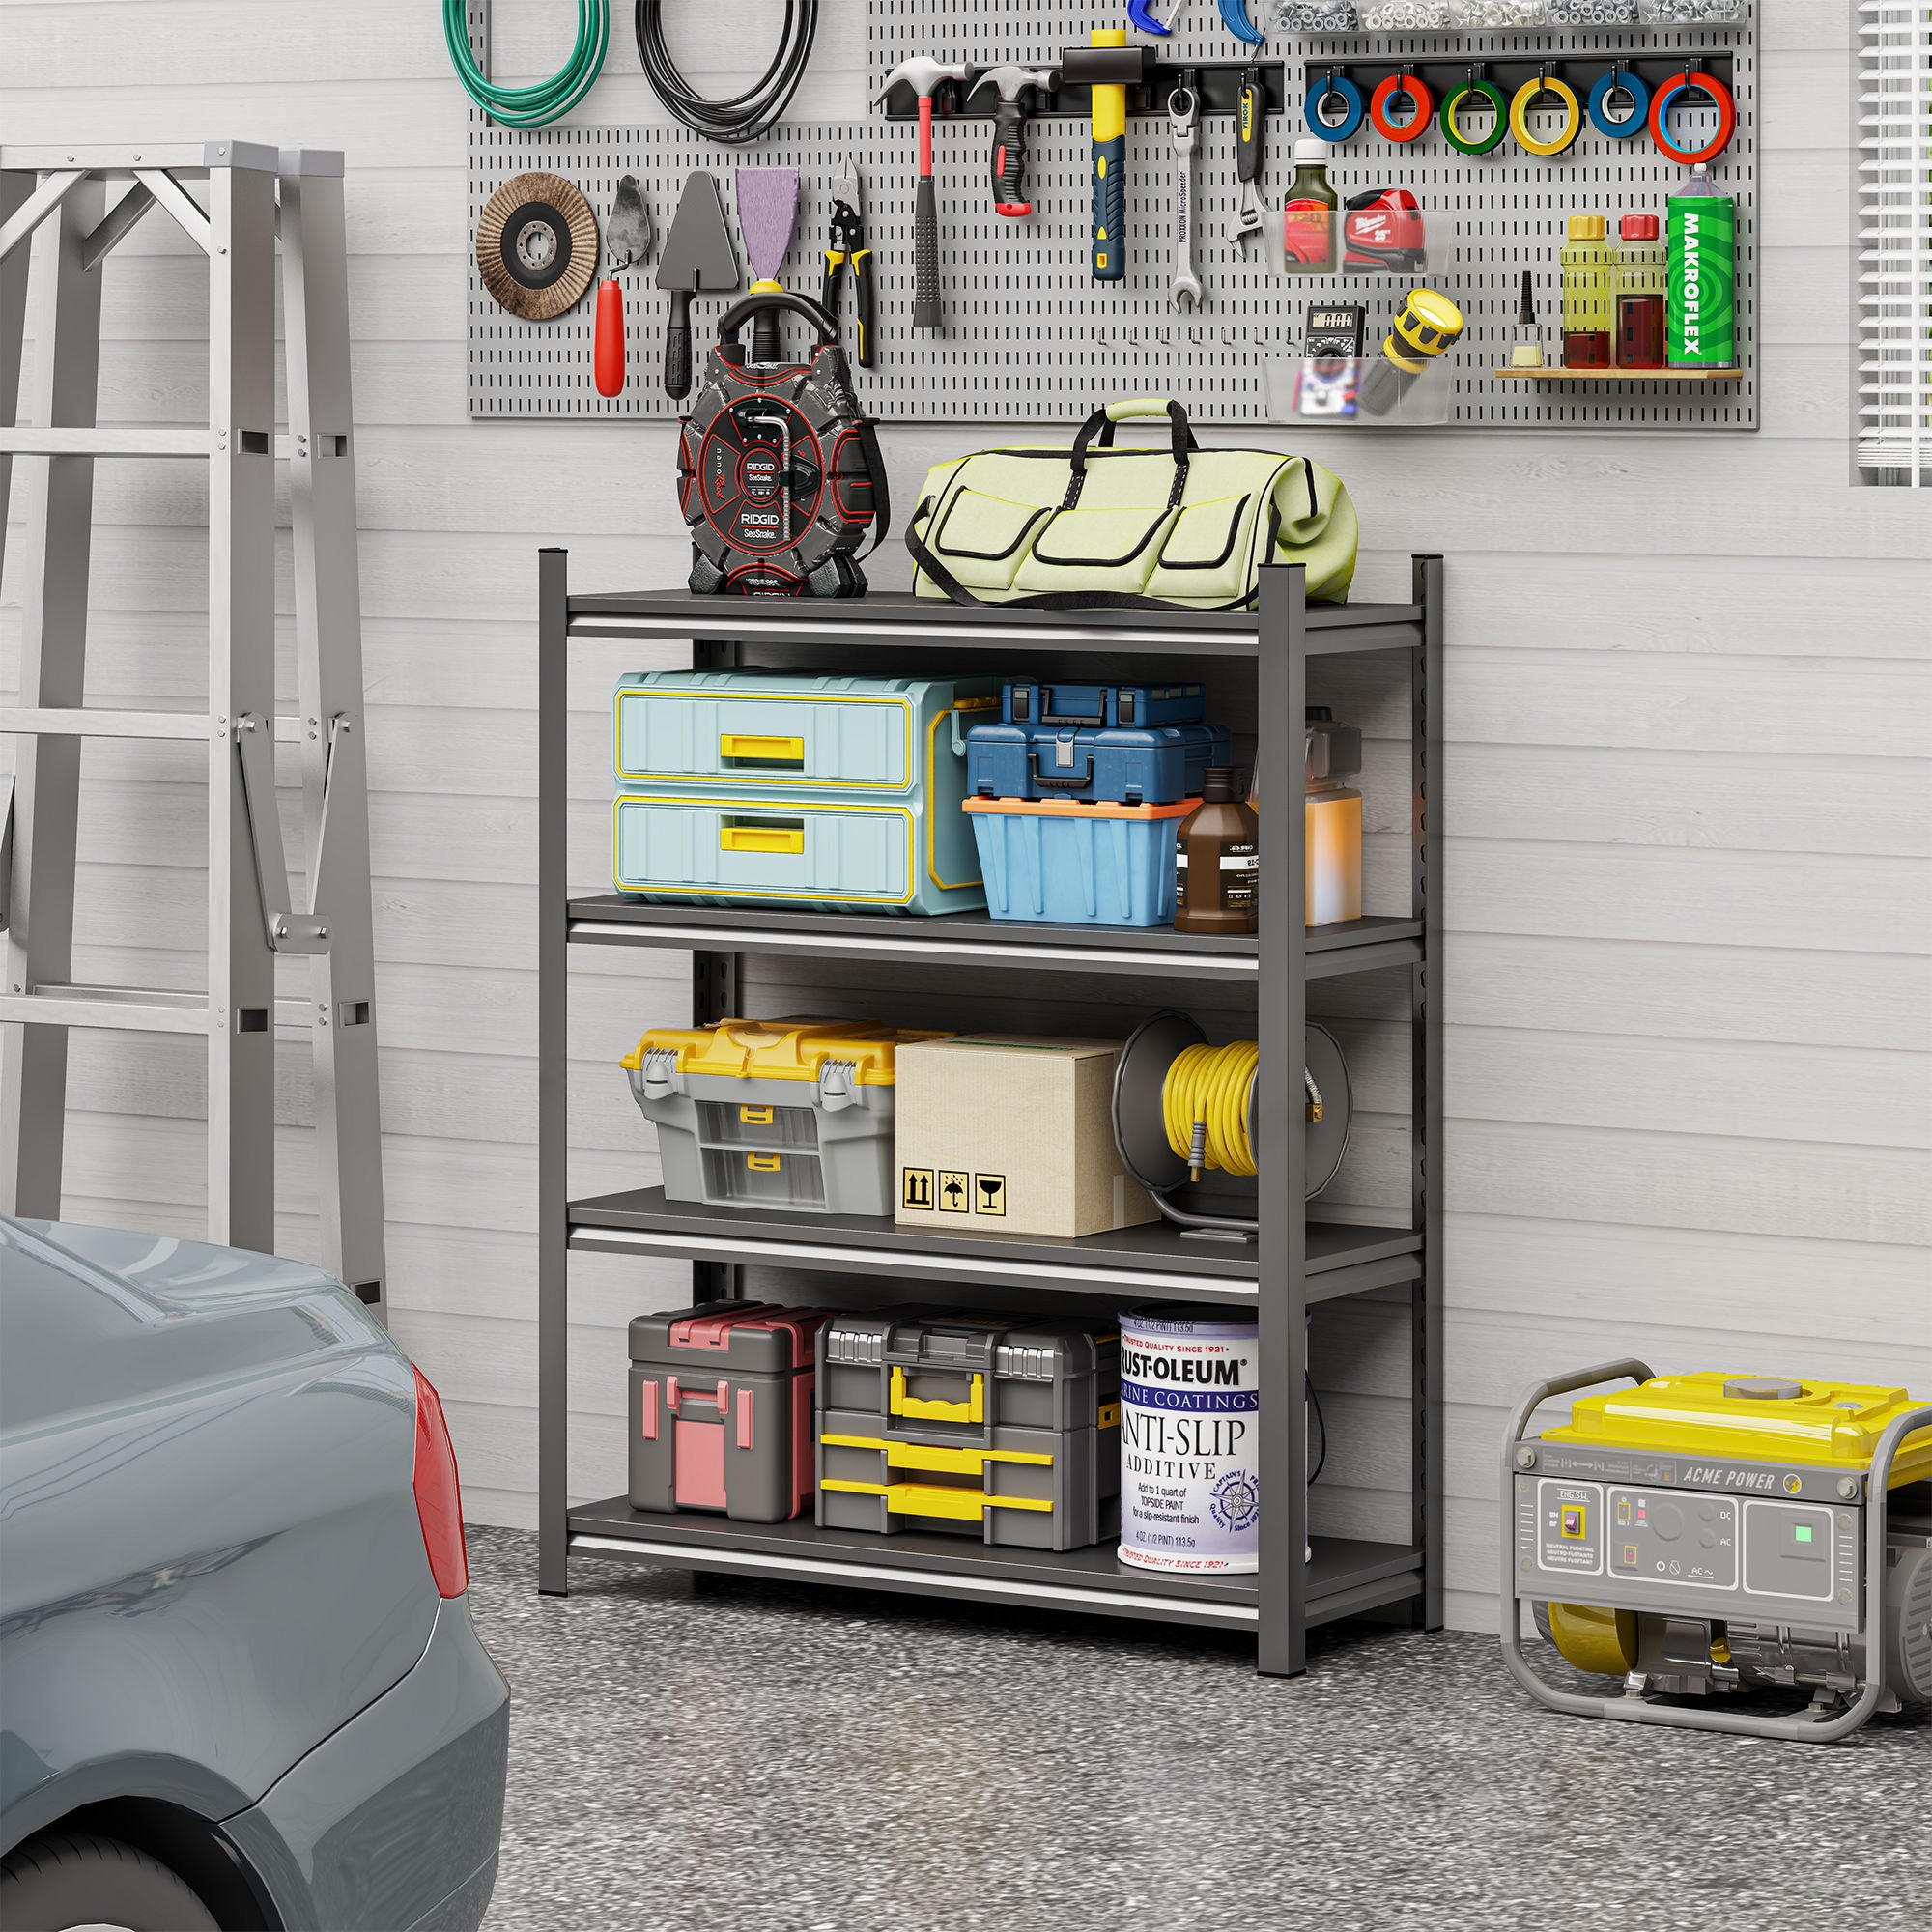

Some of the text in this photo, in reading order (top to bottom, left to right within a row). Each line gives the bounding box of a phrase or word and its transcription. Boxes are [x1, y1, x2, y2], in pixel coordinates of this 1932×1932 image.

[1179, 171, 1187, 242] PROXXON MicroSpeeder
[1684, 213, 1700, 355] MAKROFLEX
[746, 463, 775, 471] RIDGID
[741, 513, 780, 525] RIDGID
[1145, 1341, 1175, 1352] QUALITY
[1177, 1345, 1203, 1353] SINCE
[1154, 1391, 1258, 1409] COATINGS
[1126, 1453, 1216, 1480] ADDITIVE
[1684, 1466, 1776, 1491] ACME POWER
[1137, 1482, 1148, 1493] Add
[1149, 1485, 1155, 1494] to
[1161, 1488, 1179, 1498] quart
[1179, 1487, 1187, 1498] of
[1141, 1495, 1184, 1511] TOPSIDE PAINT
[1180, 1513, 1200, 1524] finish
[1720, 1511, 1731, 1520] DC
[1720, 1537, 1731, 1547] AC
[1144, 1554, 1174, 1567] QUALITY
[1175, 1559, 1203, 1569] SINCE
